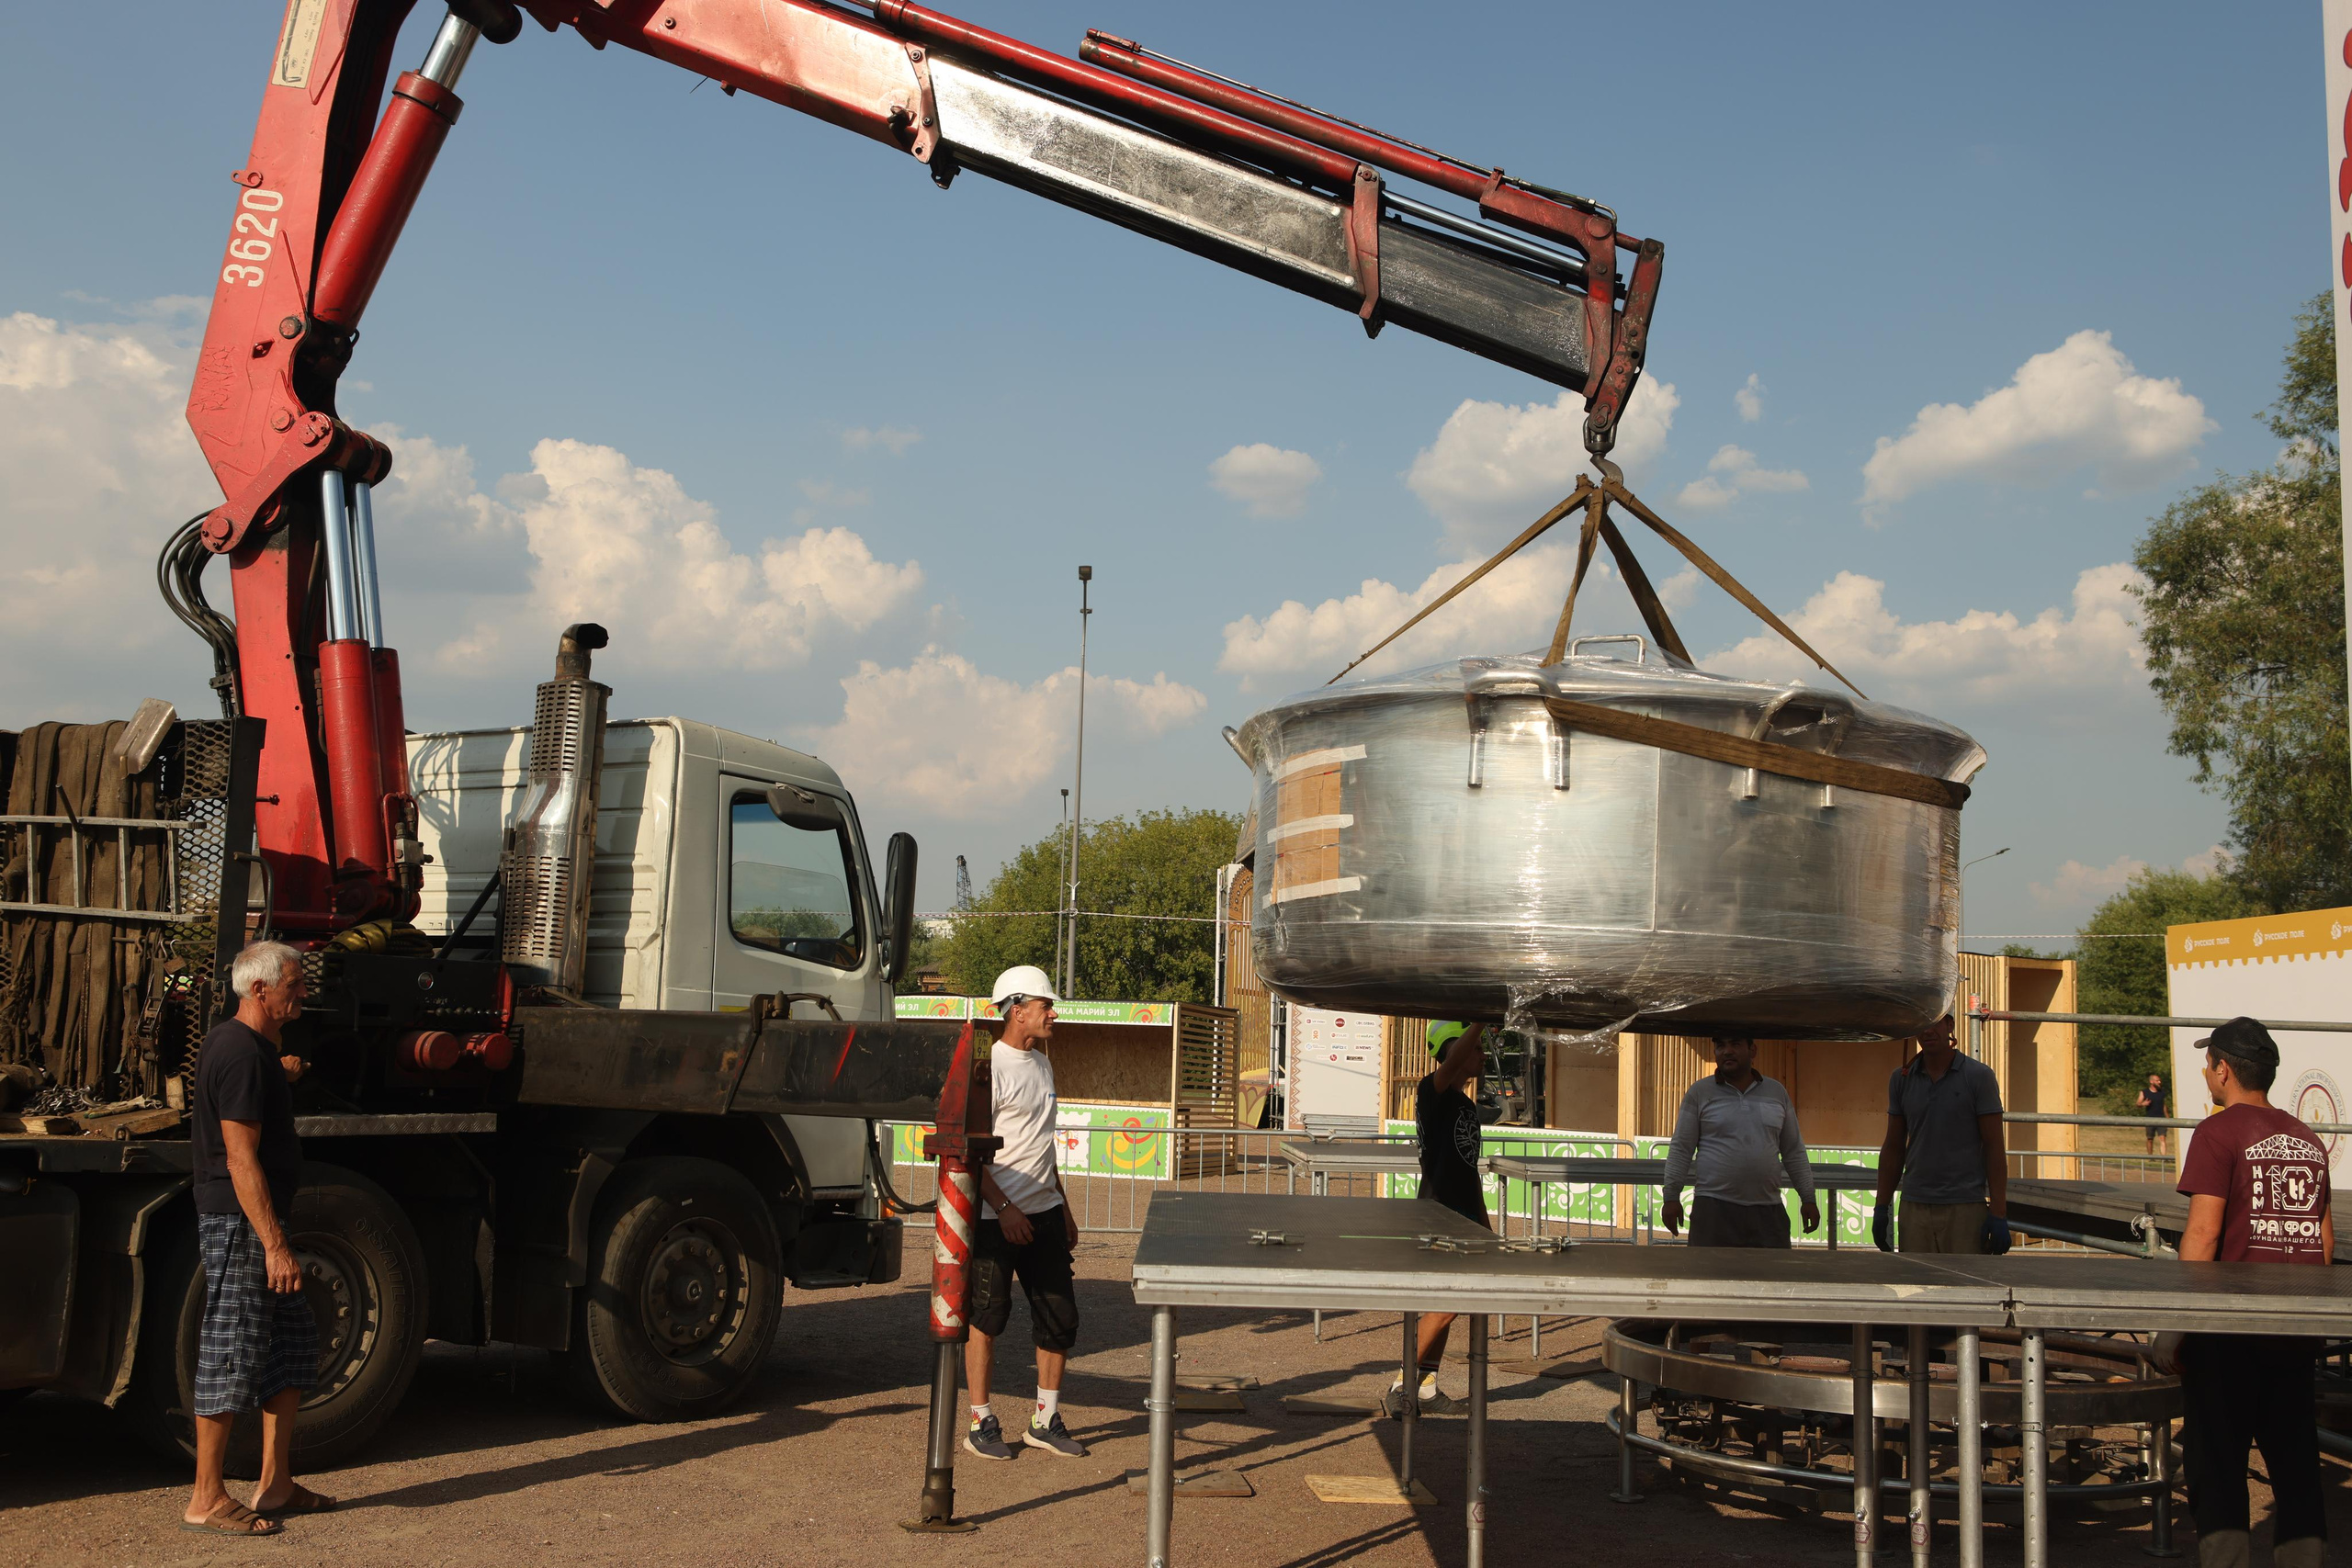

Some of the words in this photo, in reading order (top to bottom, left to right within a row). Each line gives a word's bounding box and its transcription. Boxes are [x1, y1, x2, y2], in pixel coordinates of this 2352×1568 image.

[222, 188, 284, 288] 3620
[2264, 931, 2289, 941] РУССКОЕ
[2290, 930, 2304, 939] ПОЛЕ
[2194, 939, 2215, 947] РУССКОЕ
[2216, 937, 2230, 945] ПОЛЕ
[895, 1001, 906, 1010] ИЙ
[1053, 1007, 1074, 1015] ЛИКА
[1076, 1006, 1105, 1016] МАРИЙ
[977, 1046, 982, 1057] 9
[2290, 1072, 2316, 1114] NTERNATIONAL
[2252, 1165, 2265, 1210] НАМ
